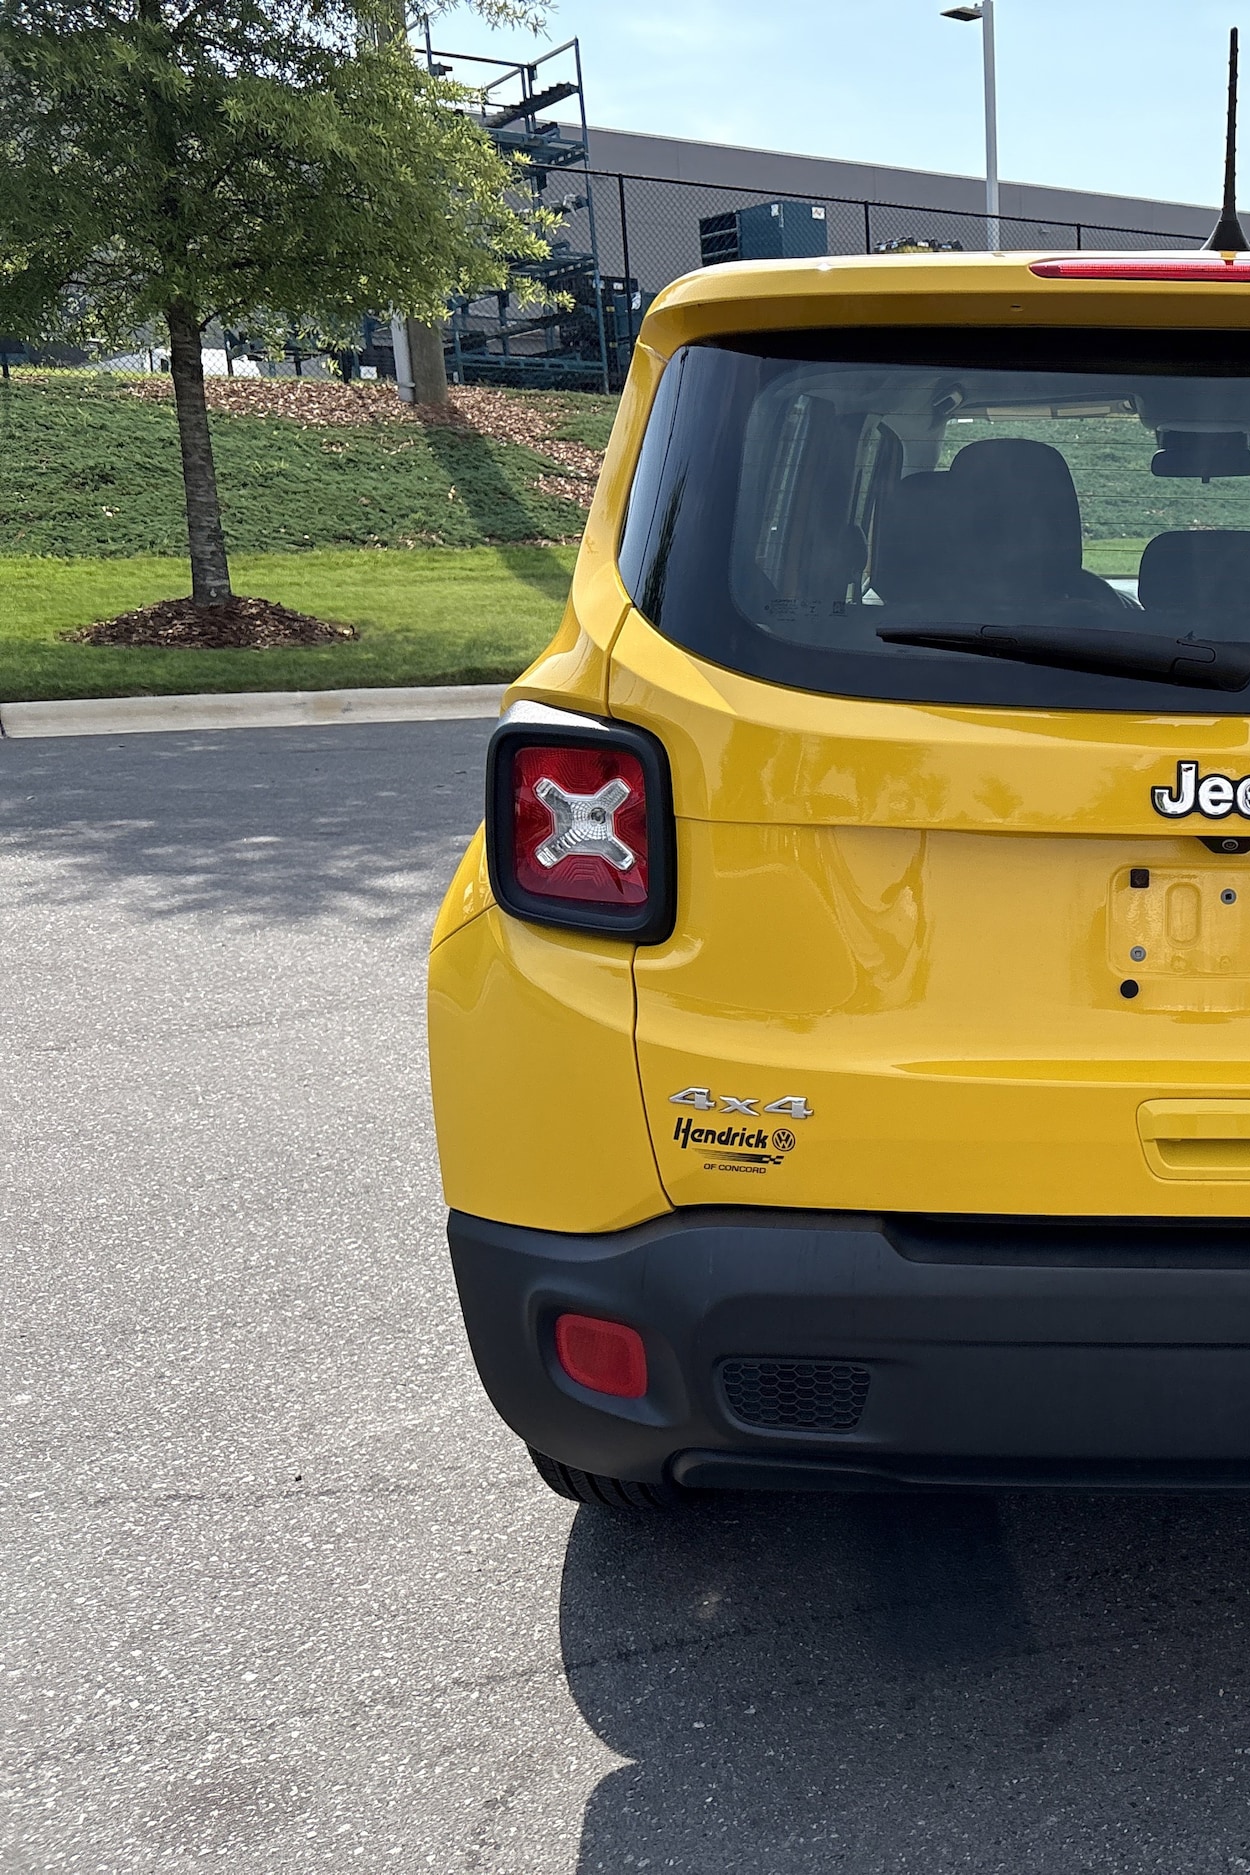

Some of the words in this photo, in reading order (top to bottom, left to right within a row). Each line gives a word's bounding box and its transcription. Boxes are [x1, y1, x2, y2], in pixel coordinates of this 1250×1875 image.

[673, 1117, 769, 1149] Hendrick
[703, 1163, 716, 1171] OF
[718, 1164, 767, 1174] CONCORD
